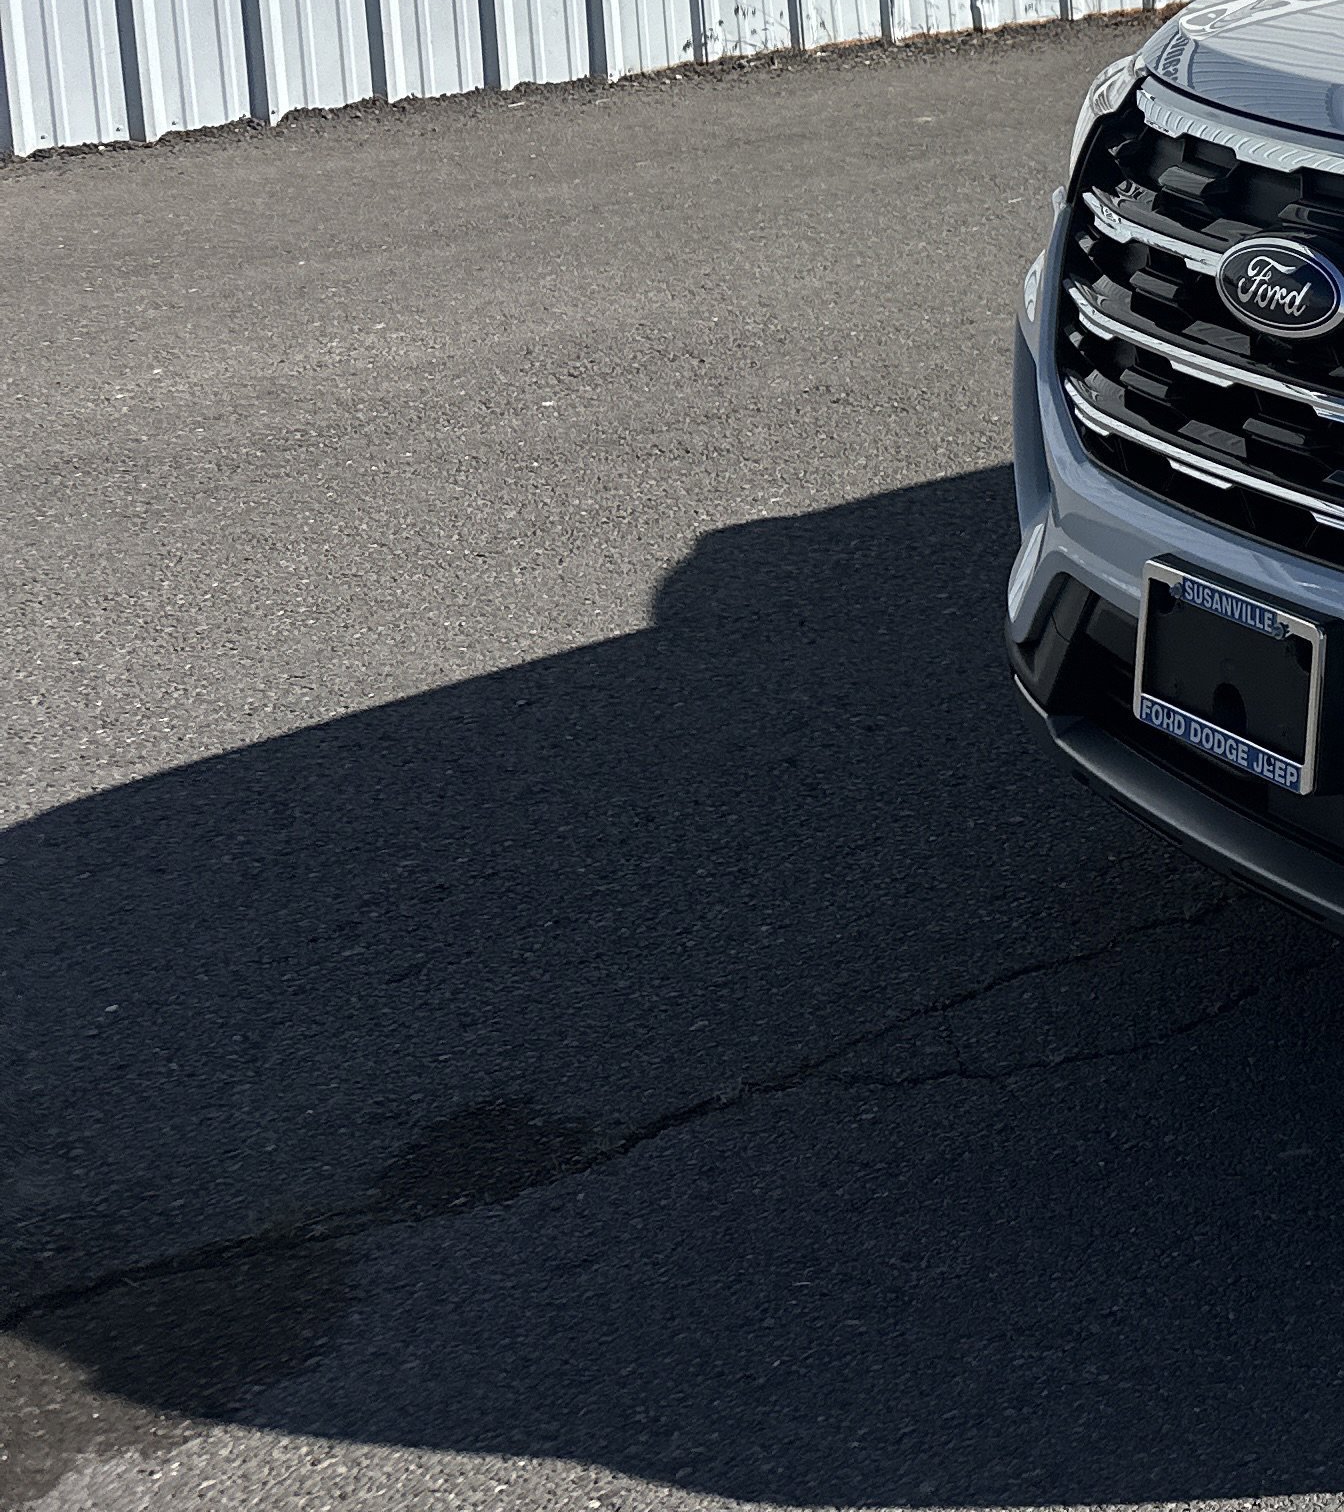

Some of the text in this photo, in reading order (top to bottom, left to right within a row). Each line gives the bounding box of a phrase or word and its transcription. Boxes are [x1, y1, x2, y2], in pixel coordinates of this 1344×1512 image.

[1237, 255, 1312, 317] Ford
[1184, 581, 1274, 634] SUSANVILLE
[1141, 698, 1299, 788] FORD DODGE JEEP
